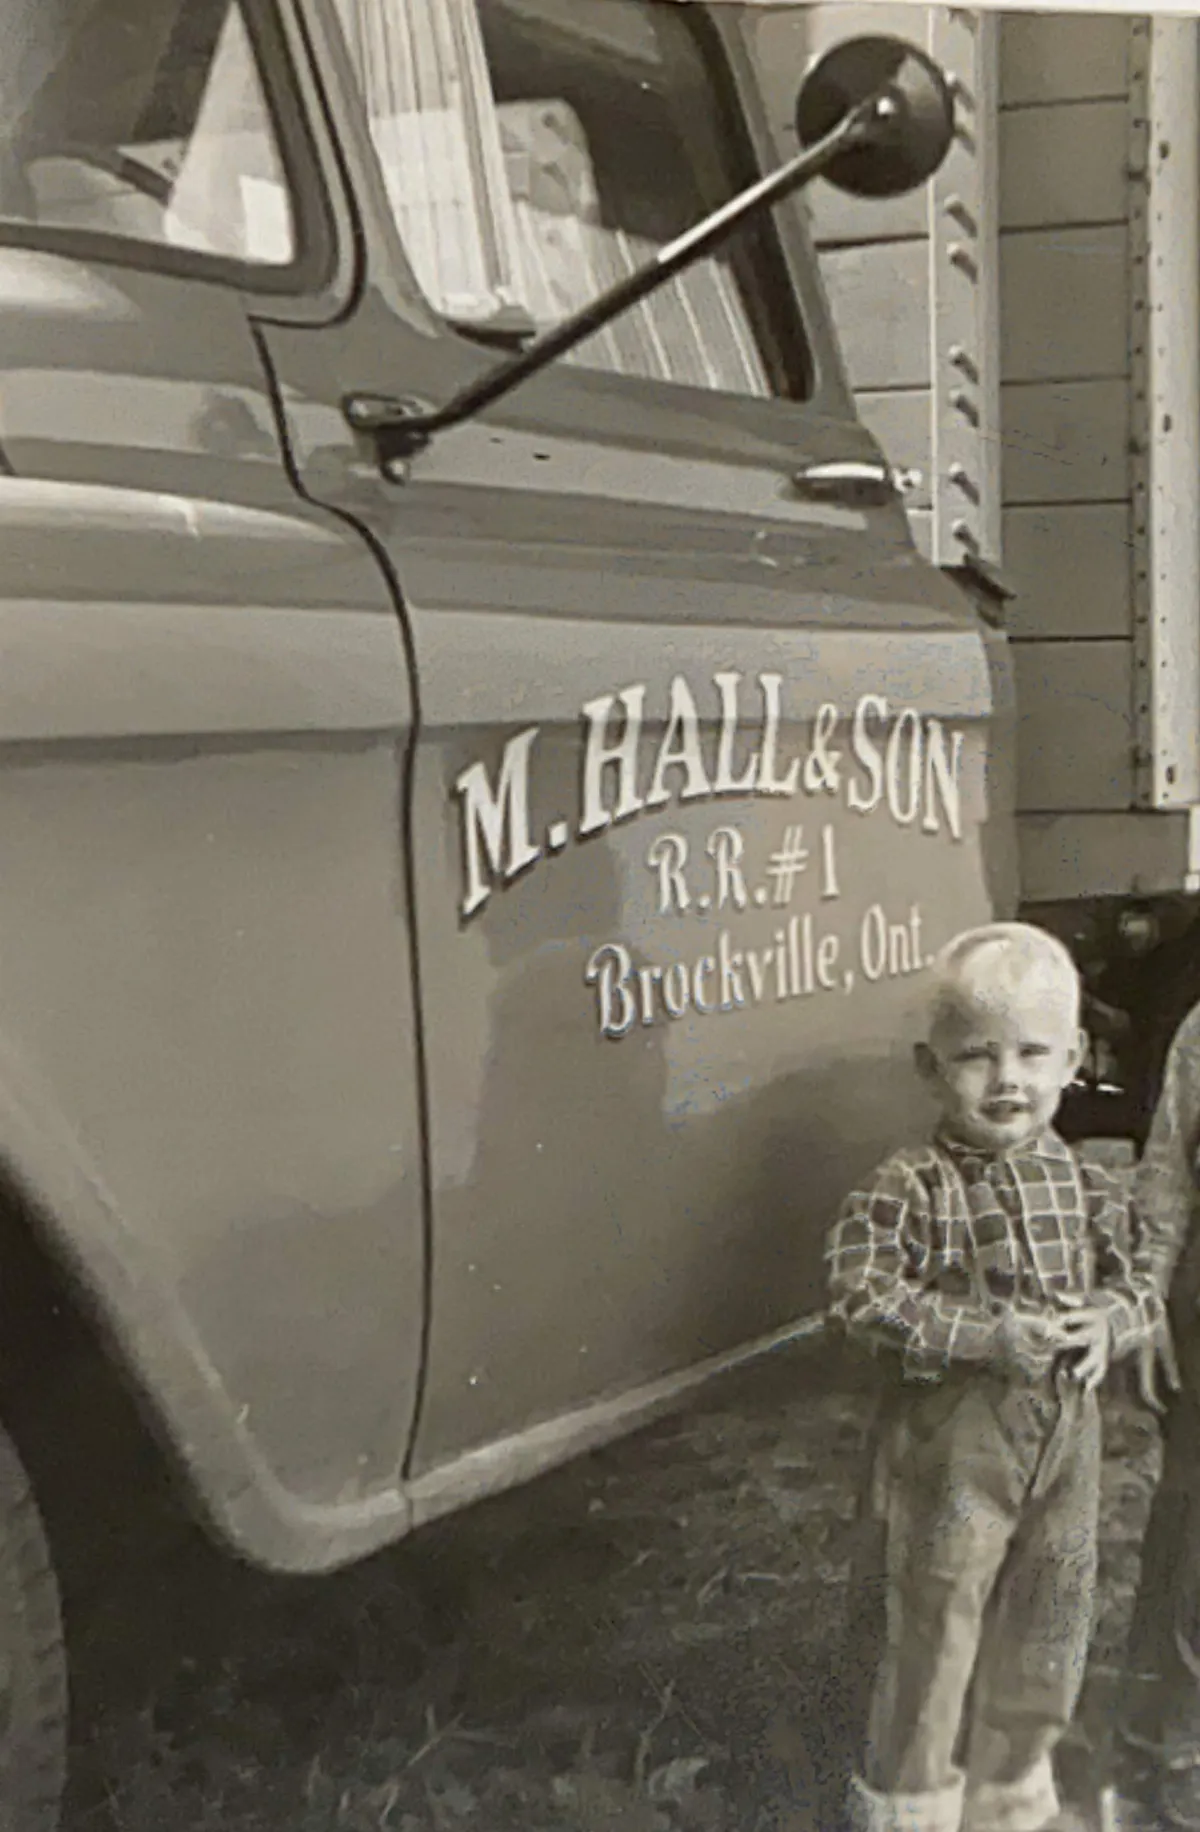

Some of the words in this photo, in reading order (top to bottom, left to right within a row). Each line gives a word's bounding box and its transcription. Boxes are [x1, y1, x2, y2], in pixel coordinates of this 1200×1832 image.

[455, 728, 568, 917] M.
[580, 672, 800, 834] HALL
[804, 703, 841, 793] &
[848, 693, 964, 840] SON
[586, 913, 854, 1039] Brockville,
[860, 903, 935, 981] Ont.
